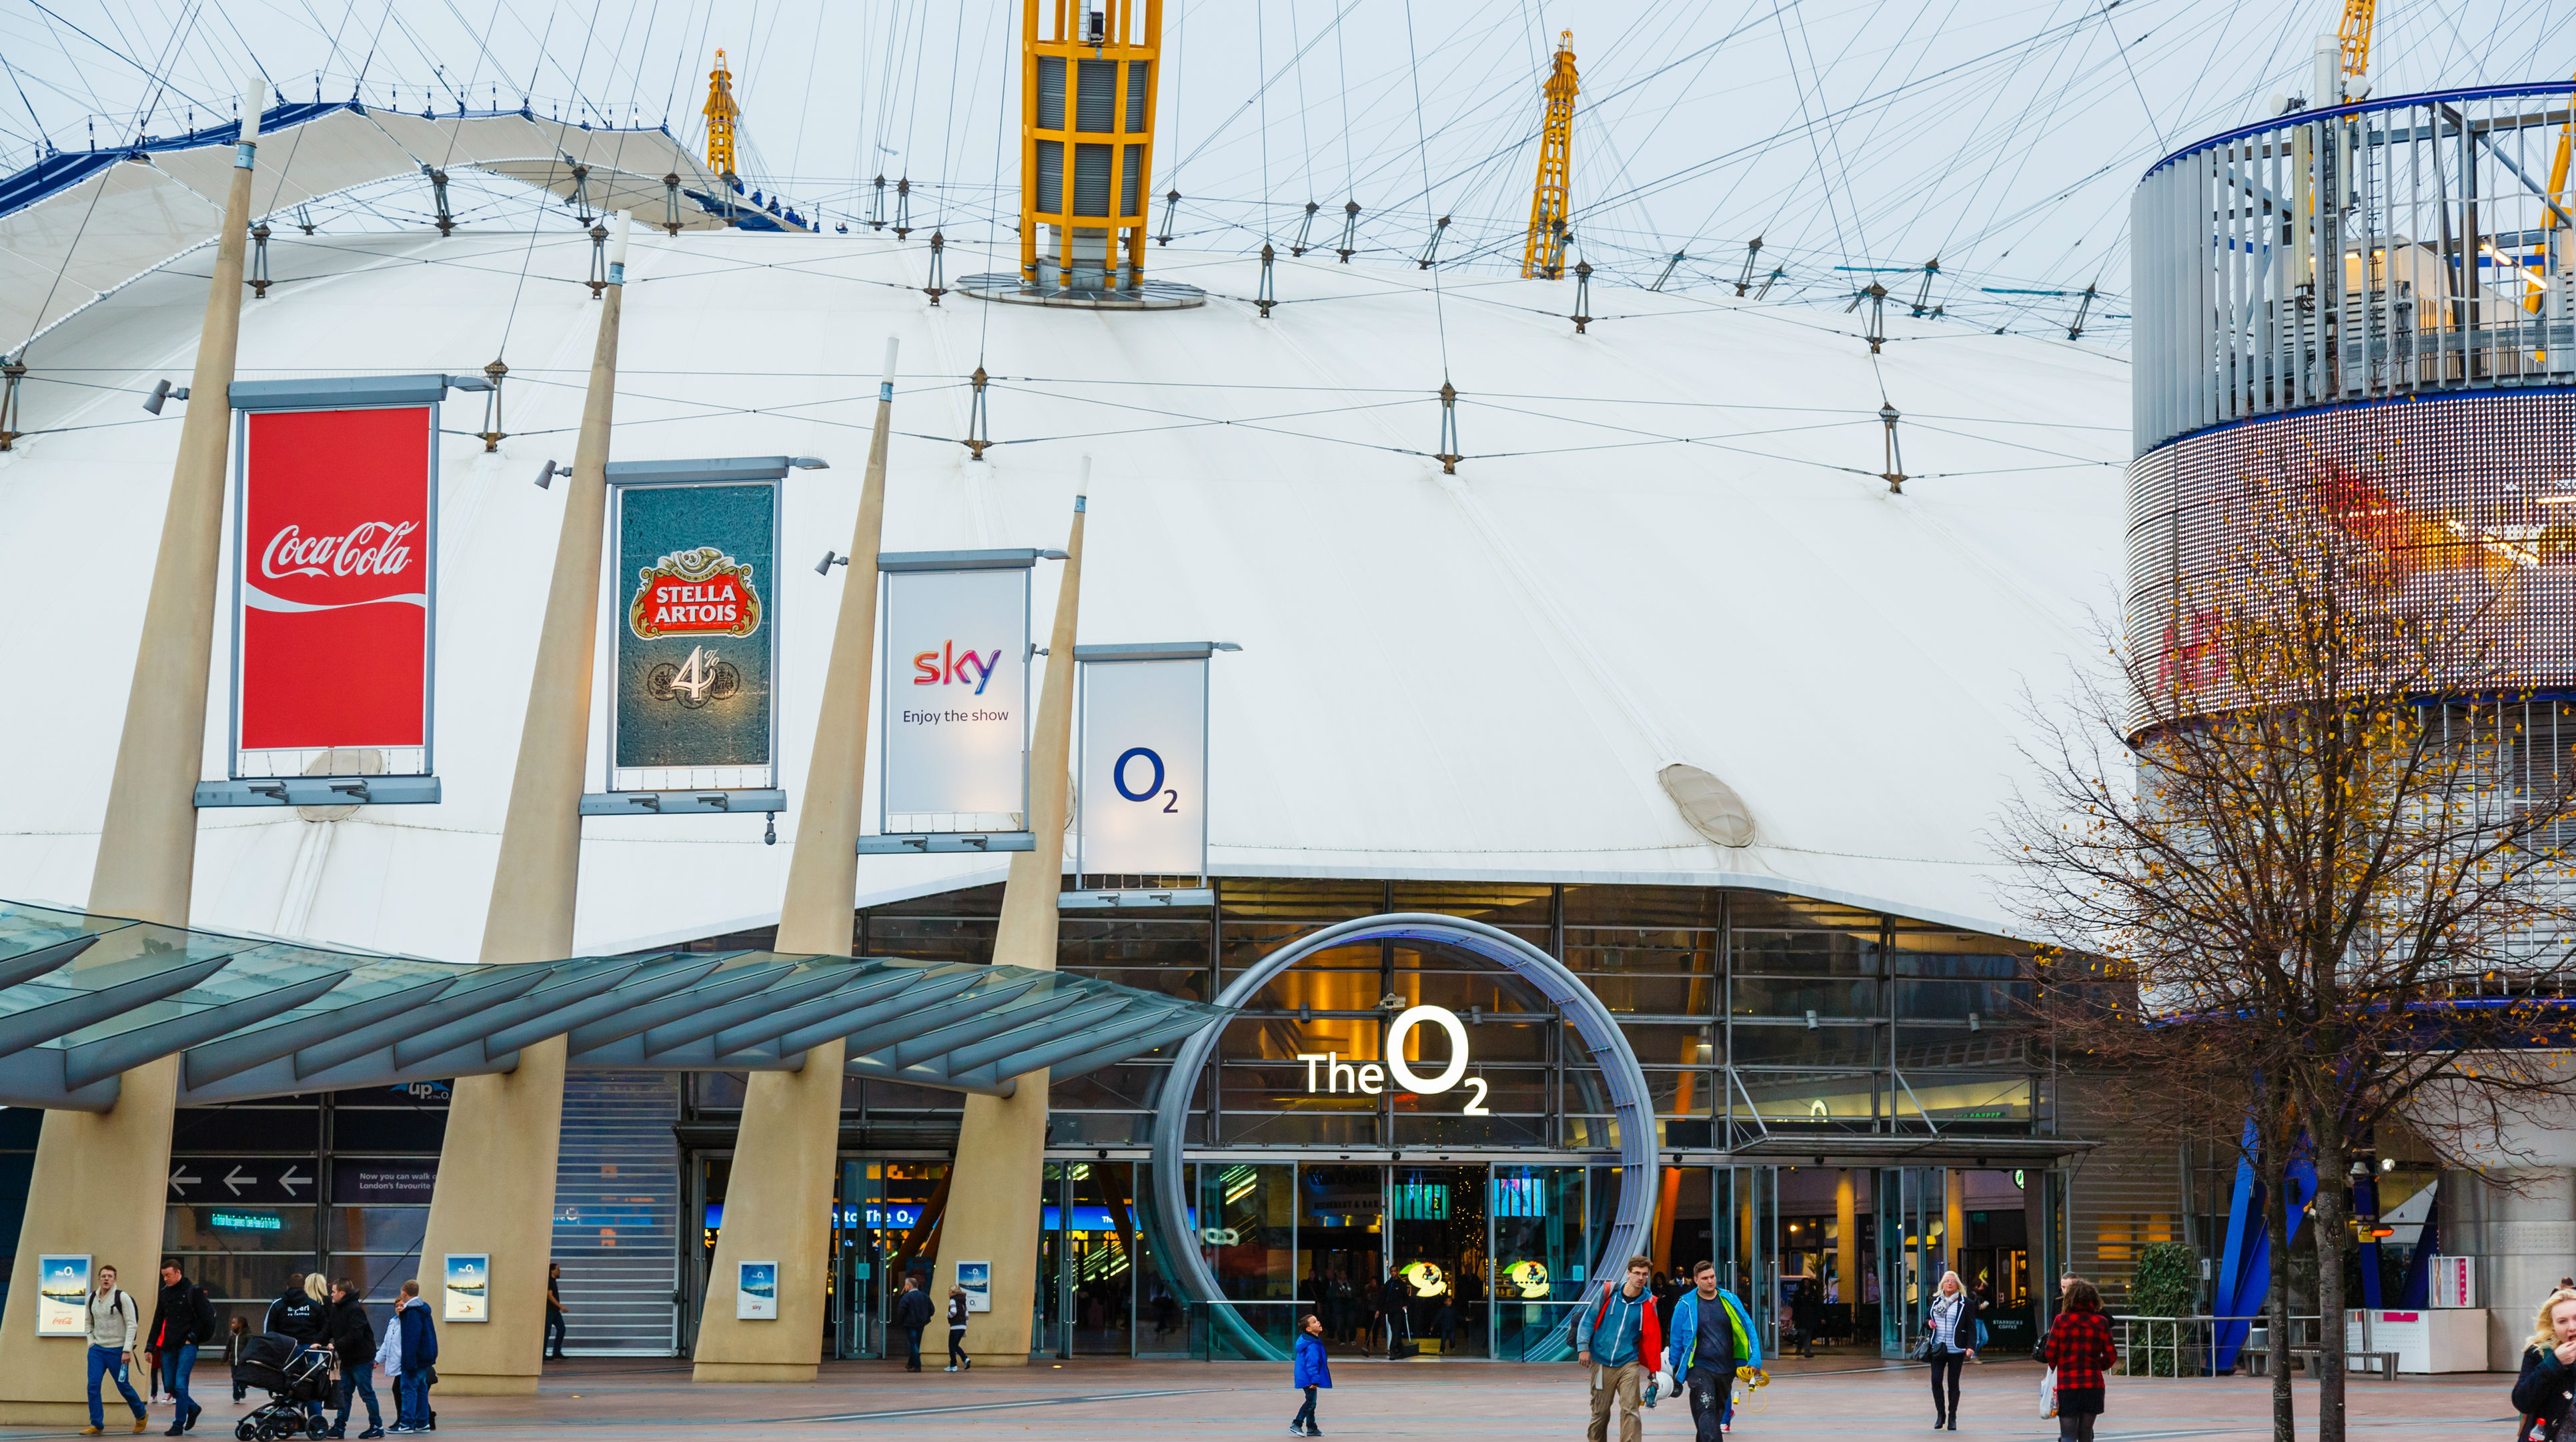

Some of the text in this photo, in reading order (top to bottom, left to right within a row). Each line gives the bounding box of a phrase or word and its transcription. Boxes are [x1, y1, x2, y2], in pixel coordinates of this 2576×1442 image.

[261, 521, 420, 579] Coca-Cola
[674, 568, 717, 580] ANNO 1366
[656, 585, 737, 604] STELLA
[654, 604, 738, 624] ARTOIS
[913, 639, 1002, 695] sky
[903, 709, 1009, 725] Enjoy the show
[1297, 1051, 1385, 1095] The
[408, 1082, 433, 1099] up
